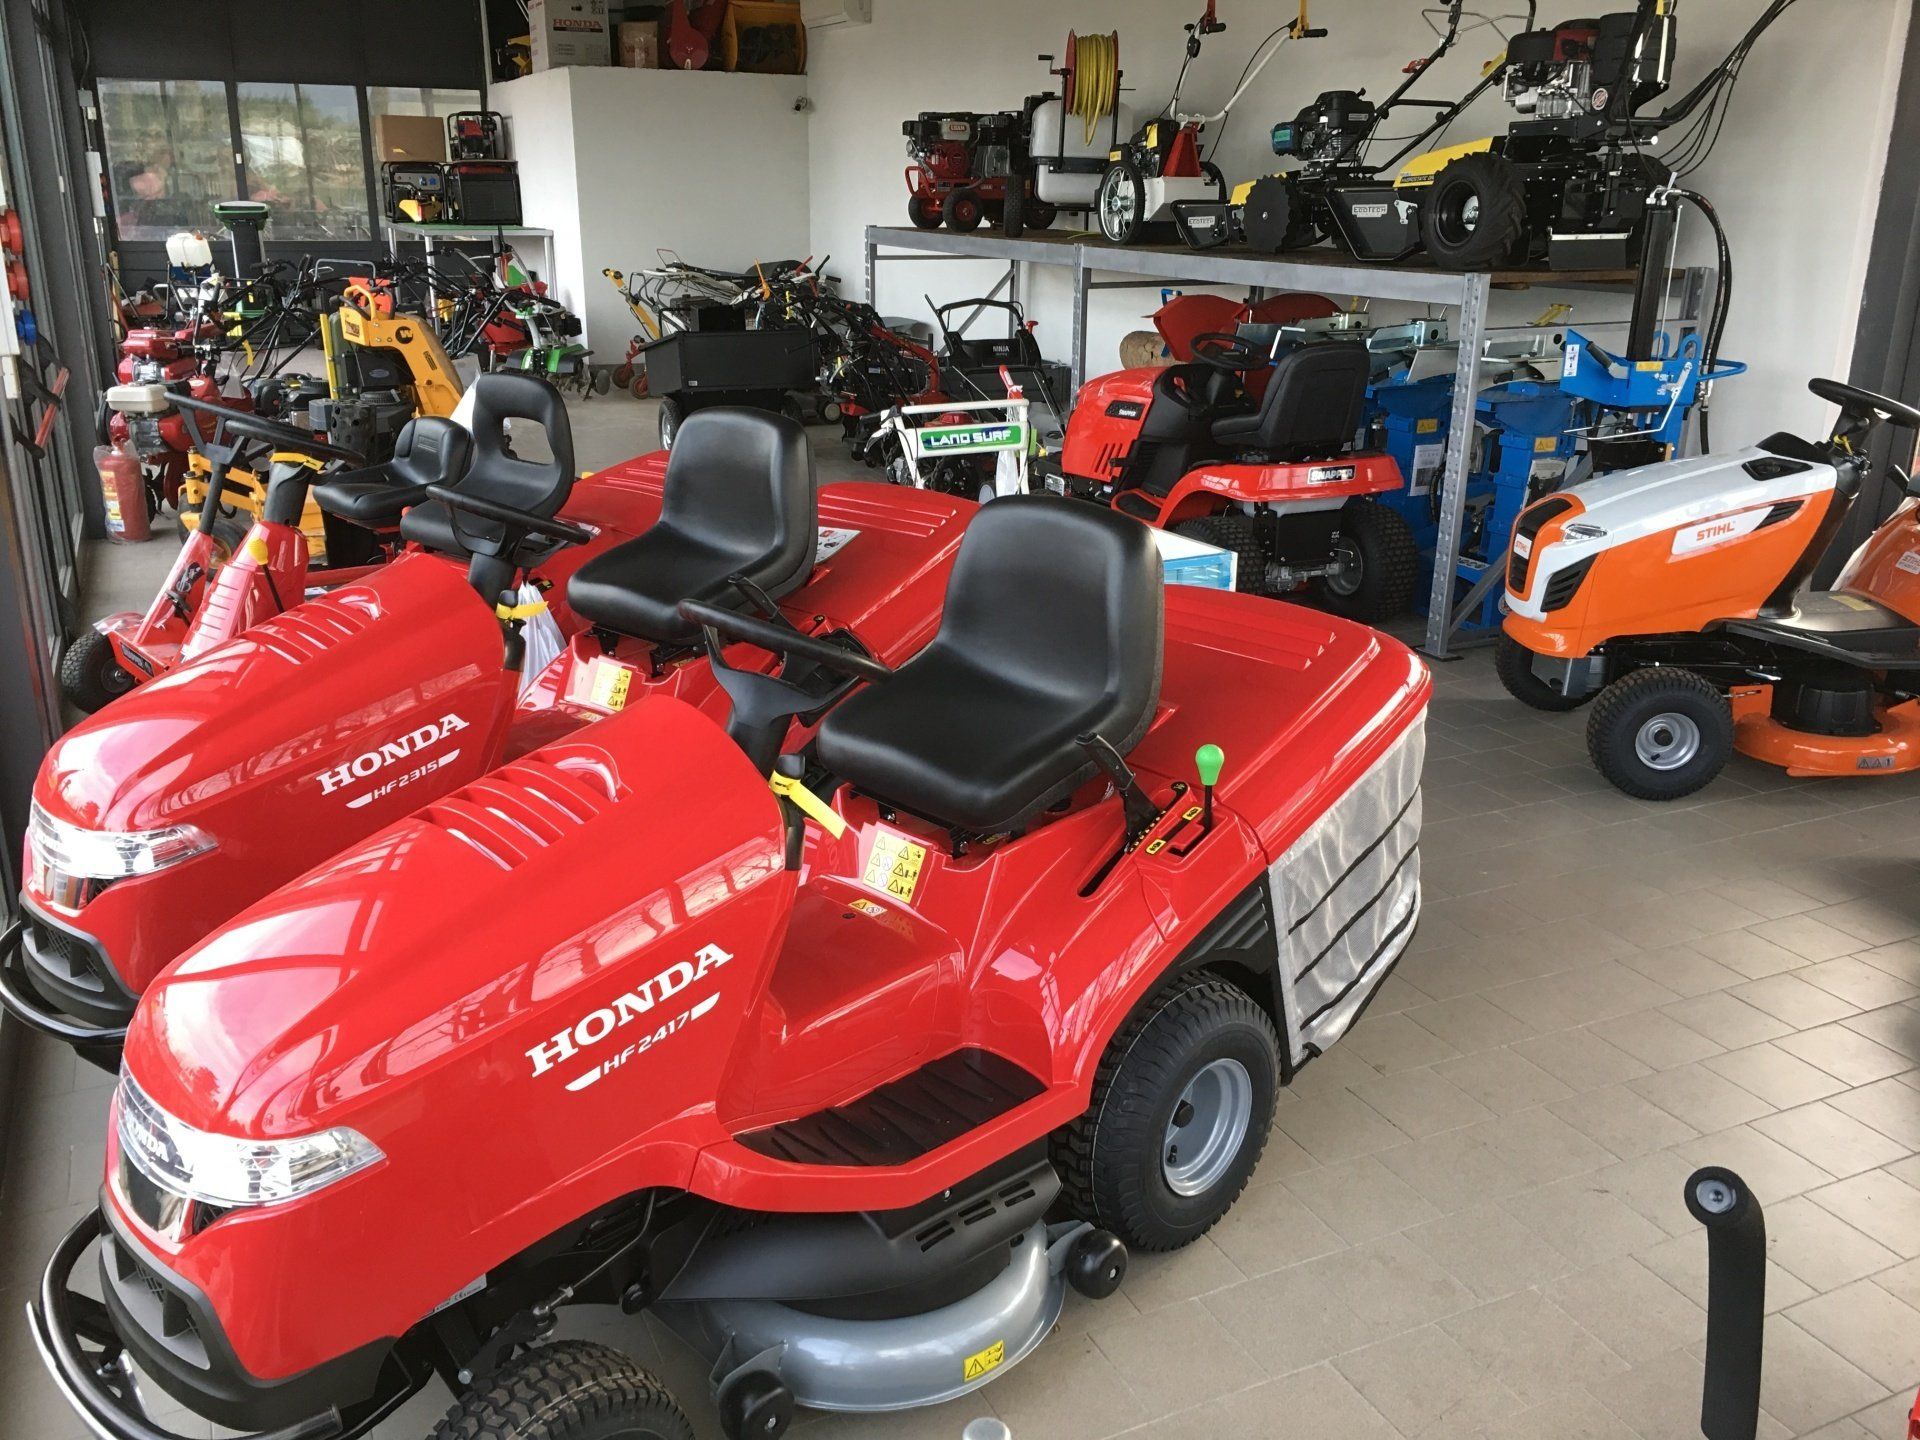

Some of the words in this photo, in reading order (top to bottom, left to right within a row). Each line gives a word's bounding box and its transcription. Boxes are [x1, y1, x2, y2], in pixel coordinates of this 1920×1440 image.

[553, 19, 602, 28] HONDA
[1354, 205, 1387, 214] ECOTECH
[930, 432, 970, 446] LAND
[972, 430, 1011, 442] SURF
[1311, 468, 1353, 480] SNAPPER
[1696, 522, 1735, 541] STIHL
[316, 713, 470, 796] HONDA
[525, 943, 734, 1078] HONDA
